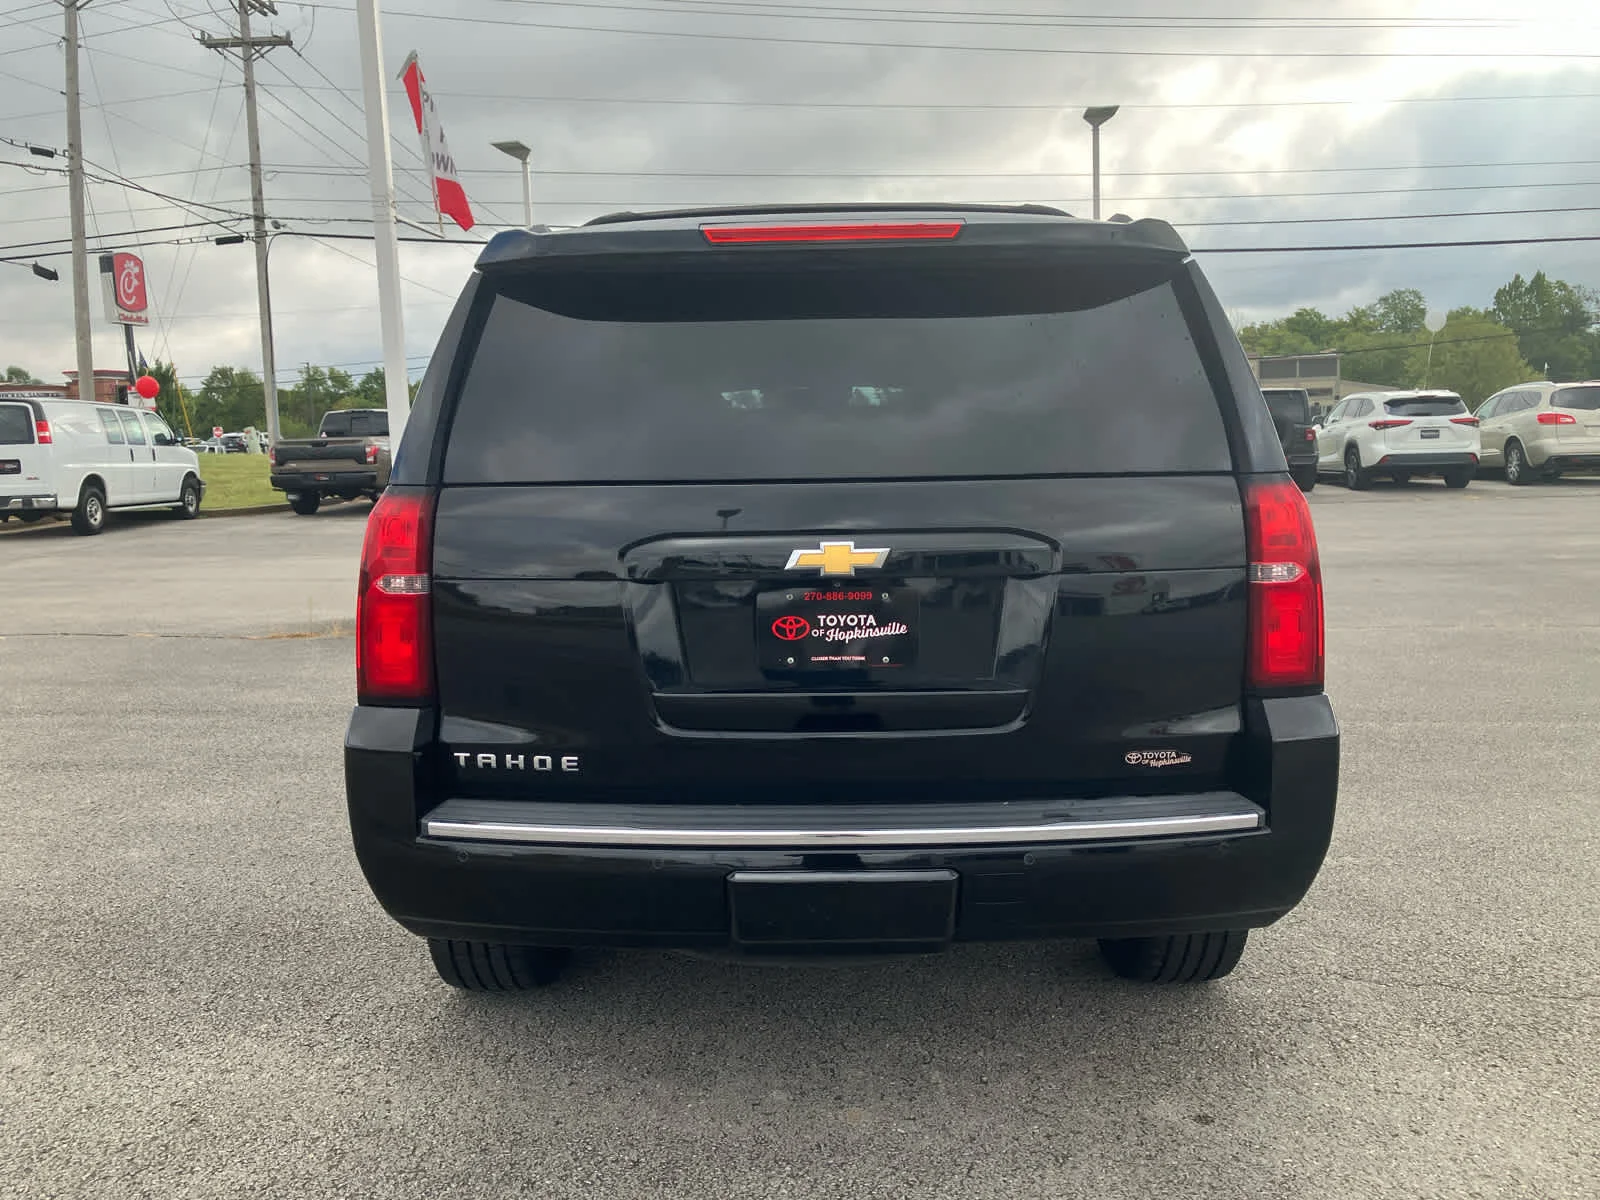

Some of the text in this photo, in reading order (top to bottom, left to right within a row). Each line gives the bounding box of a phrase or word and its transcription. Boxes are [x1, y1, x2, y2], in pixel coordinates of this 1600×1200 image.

[803, 591, 873, 601] 270-886-9099
[817, 614, 877, 627] TOYOTA
[811, 621, 908, 644] OF Hopkinsville
[1142, 751, 1177, 759] TOYOTA
[453, 752, 580, 772] TAHOE
